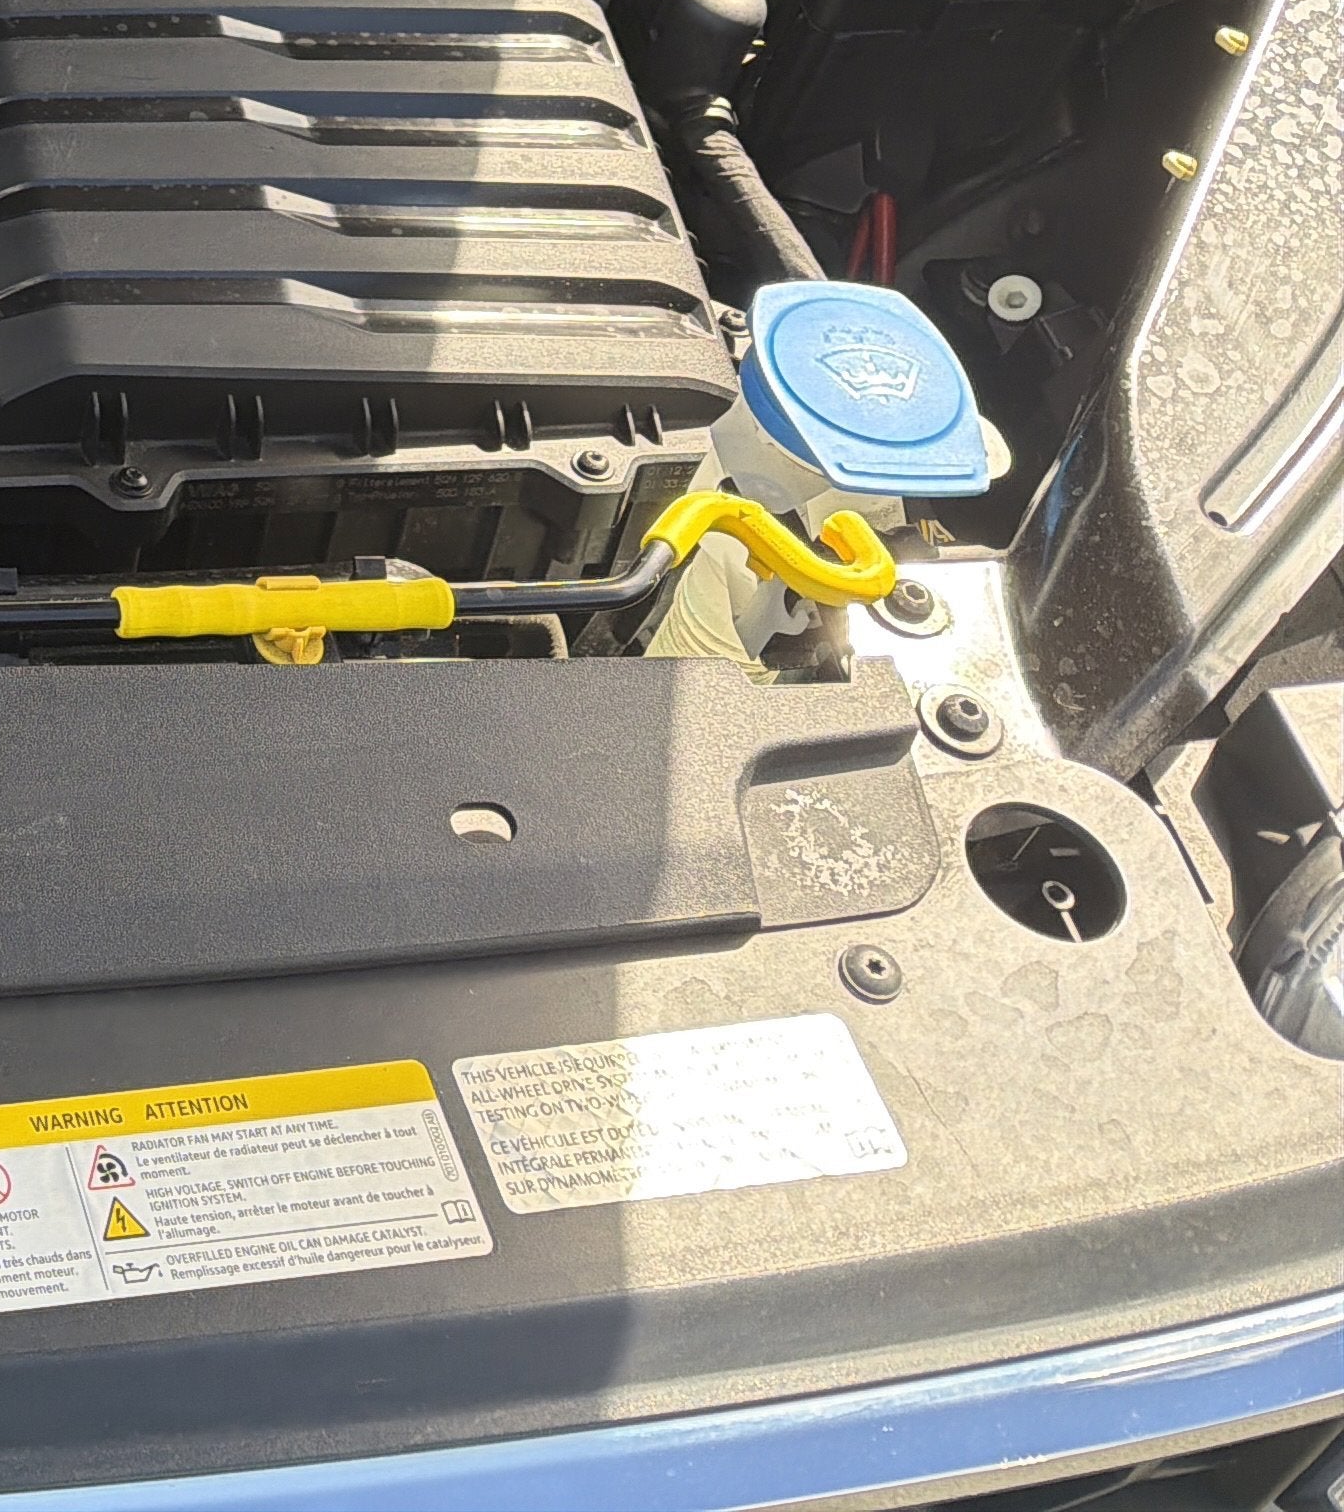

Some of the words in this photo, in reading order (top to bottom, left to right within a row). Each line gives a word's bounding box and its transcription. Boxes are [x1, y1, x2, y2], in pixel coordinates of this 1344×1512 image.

[462, 1069, 494, 1084] THIS
[496, 1062, 556, 1080] VEHICLE
[469, 1083, 550, 1103] ALL-WHEEL
[28, 1107, 123, 1132] WARNING
[145, 1093, 249, 1120] ATTENTION
[478, 1104, 538, 1122] TESTING
[540, 1101, 564, 1115] ON
[130, 1136, 186, 1151] RADIATOR
[186, 1133, 209, 1145] FAN
[210, 1130, 233, 1143] MAY
[235, 1126, 268, 1140] START
[270, 1124, 282, 1136] AT
[285, 1122, 306, 1134] ANY
[306, 1118, 339, 1131] TIME.
[134, 1155, 149, 1167] Le
[150, 1150, 210, 1165] ventilateur
[212, 1146, 227, 1158] de
[228, 1142, 278, 1157] radiateur
[280, 1138, 307, 1152] peut
[308, 1138, 321, 1147] se
[323, 1129, 381, 1146] déclencher
[383, 1127, 392, 1139] à
[392, 1125, 418, 1138] tout
[490, 1141, 513, 1154] CE
[511, 1130, 579, 1152] VÉHICULE
[581, 1129, 606, 1143] EST
[139, 1166, 191, 1180] moment.
[496, 1150, 573, 1174] INTÉGRALE
[144, 1186, 173, 1199] HIGH
[173, 1180, 226, 1195] VOLTAGE,
[226, 1174, 269, 1190] SWITCH
[270, 1172, 291, 1185] OFF
[292, 1167, 335, 1182] ENGINE
[335, 1162, 379, 1177] BEFORE
[377, 1155, 436, 1172] TOUCHING
[506, 1180, 536, 1195] SUR
[148, 1196, 199, 1212] IGNITION
[200, 1191, 247, 1206] SYSTEM.
[153, 1215, 189, 1227] Haute
[189, 1209, 236, 1223] tension,
[236, 1204, 275, 1218] arrêter
[275, 1201, 288, 1213] le
[289, 1198, 330, 1212] moteur
[332, 1193, 365, 1207] avant
[365, 1191, 380, 1203] de
[381, 1186, 424, 1201] toucher
[425, 1183, 434, 1196] à
[157, 1225, 221, 1240] l'allumage.
[165, 1247, 233, 1266] OVERFILLED
[233, 1242, 277, 1258] ENGINE
[278, 1240, 298, 1252] OIL
[297, 1237, 322, 1250] CAN
[323, 1231, 371, 1247] DAMAGE
[371, 1225, 427, 1241] CATALYST.
[2, 1255, 24, 1269] très
[25, 1250, 64, 1266] chauds
[65, 1249, 92, 1261] dans
[169, 1264, 240, 1280] Remplissage
[242, 1255, 285, 1272] excessif
[287, 1251, 325, 1266] d'huile
[326, 1247, 384, 1262] dangereux
[385, 1243, 411, 1257] pour
[411, 1240, 424, 1251] le
[425, 1235, 485, 1250] catalyseur.
[33, 1266, 79, 1279] moteur.
